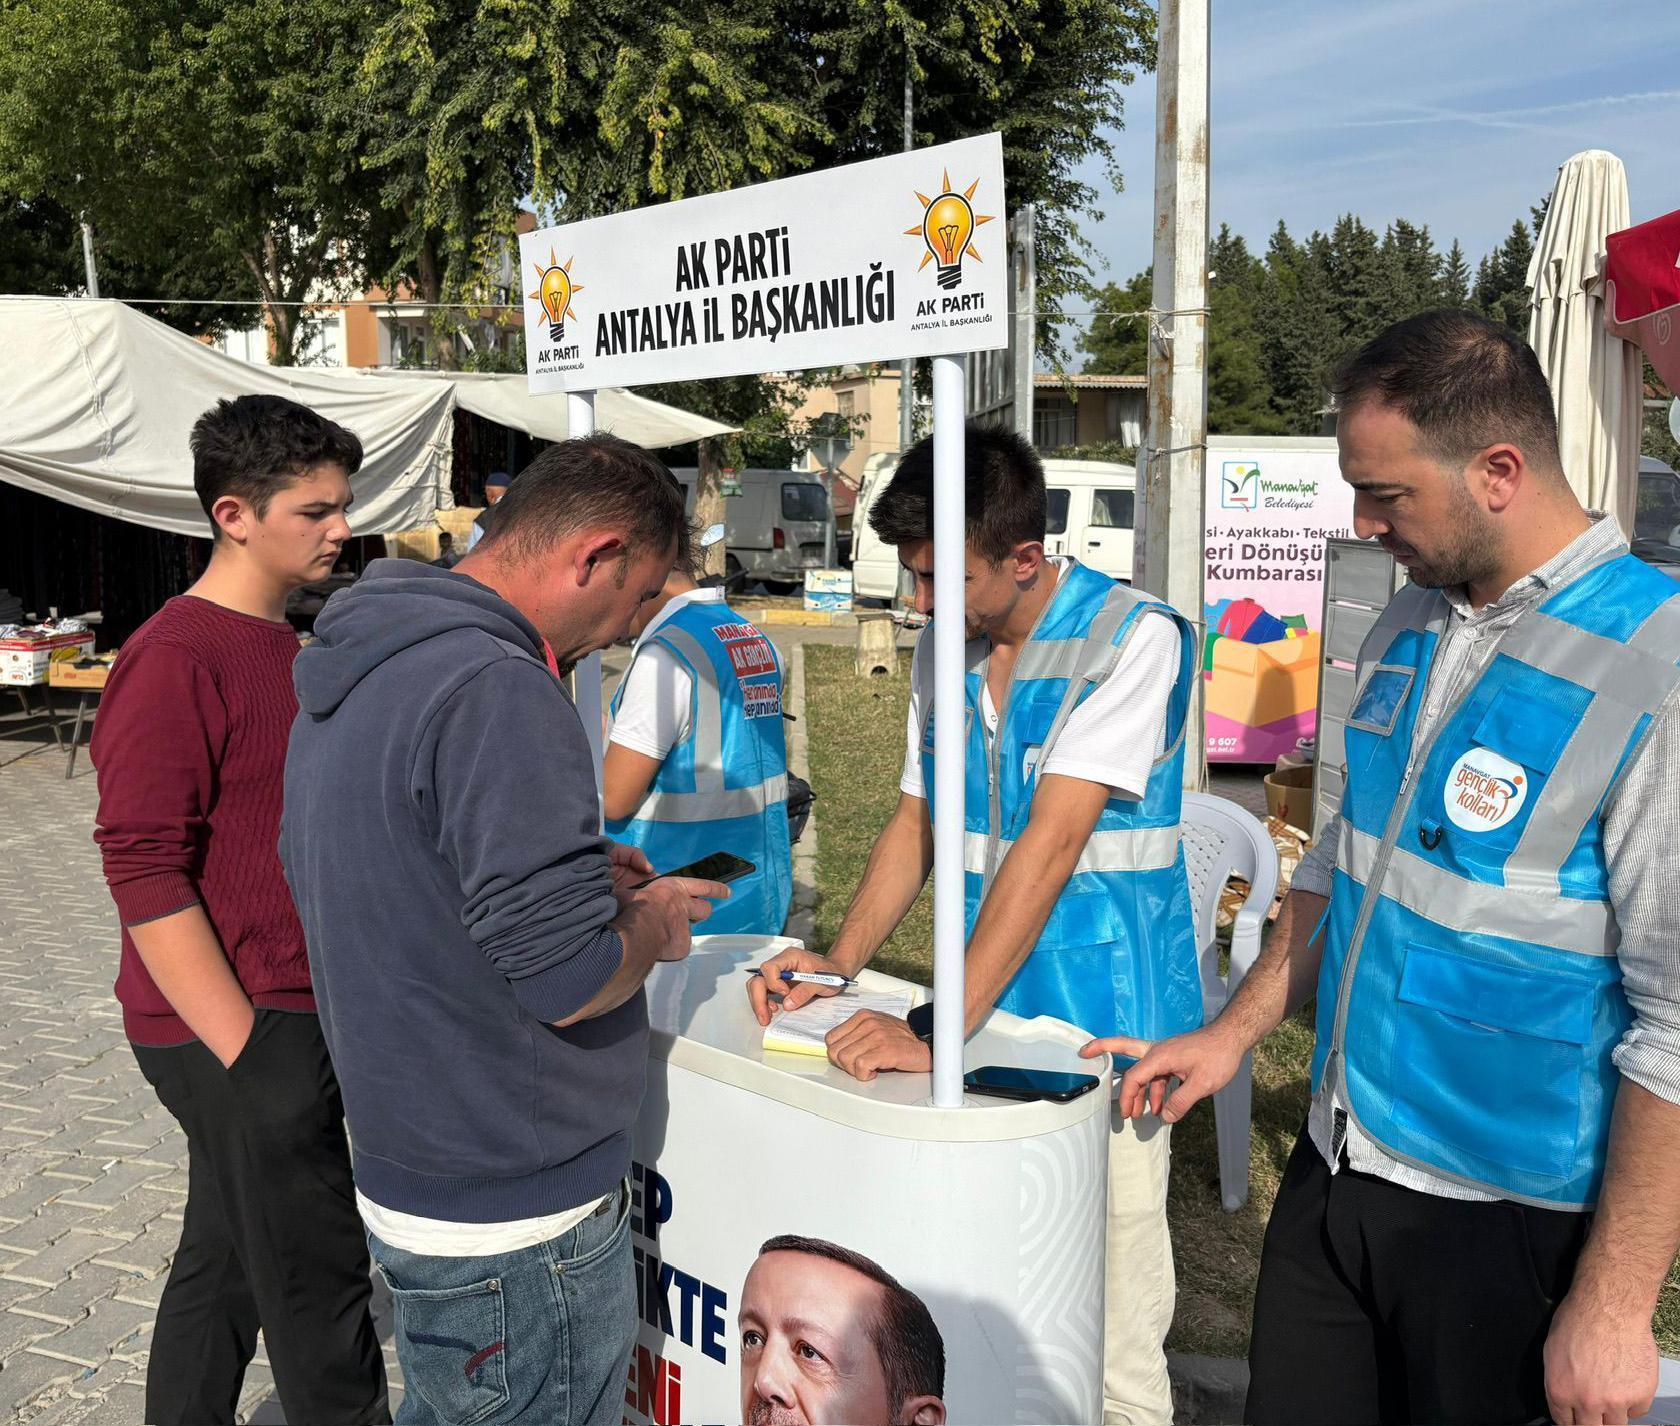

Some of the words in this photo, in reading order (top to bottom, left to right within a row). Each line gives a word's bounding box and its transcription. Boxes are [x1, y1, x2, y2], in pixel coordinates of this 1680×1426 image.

[676, 242, 707, 292] AK
[595, 303, 697, 357] ANTALYA
[732, 261, 895, 343] BAŞKANLIĞI
[916, 299, 937, 317] AK
[911, 321, 940, 332] ANTALYA
[950, 313, 993, 327] BAŞKANLIĞI
[538, 350, 550, 364] AK
[536, 366, 553, 374] ANTALYA
[1260, 479, 1318, 498] Manavgat
[1264, 496, 1314, 511] Belediyesi
[1206, 526, 1217, 538] si
[1226, 527, 1294, 541] Ayakkabı
[1303, 528, 1349, 539] Tekstil
[1205, 543, 1233, 561] eri
[1241, 543, 1323, 566] Dönüşü
[1207, 564, 1322, 582] Kumbarası
[1208, 737, 1216, 746] 9
[1218, 737, 1237, 746] 607
[1463, 763, 1491, 779] MANAVGAT
[1454, 768, 1501, 799] gençlik
[1456, 787, 1499, 822] kolları
[631, 1160, 673, 1242] EP
[633, 1245, 727, 1365] İKTE
[622, 1343, 681, 1426] ENİ
